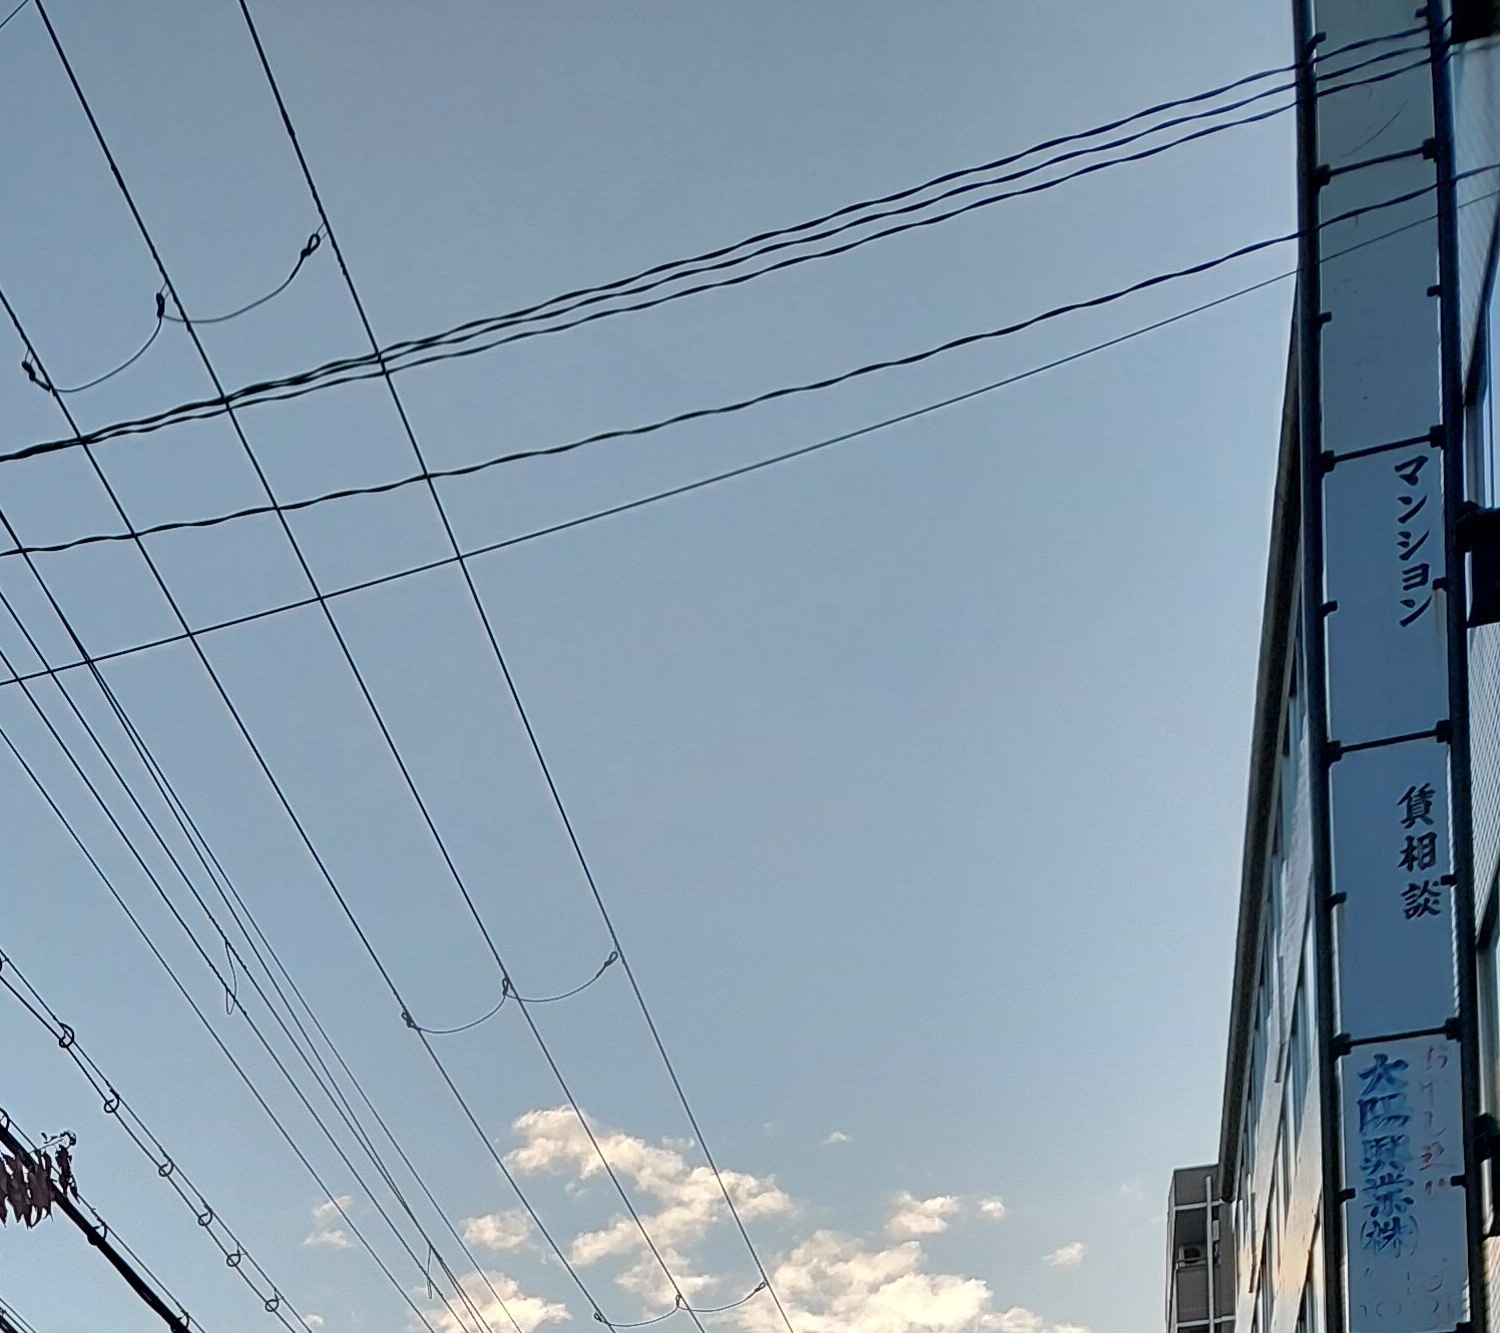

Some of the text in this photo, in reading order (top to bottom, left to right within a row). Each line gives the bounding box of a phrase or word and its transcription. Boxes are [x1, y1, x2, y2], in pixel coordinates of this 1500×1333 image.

[1393, 455, 1433, 627] マンション
